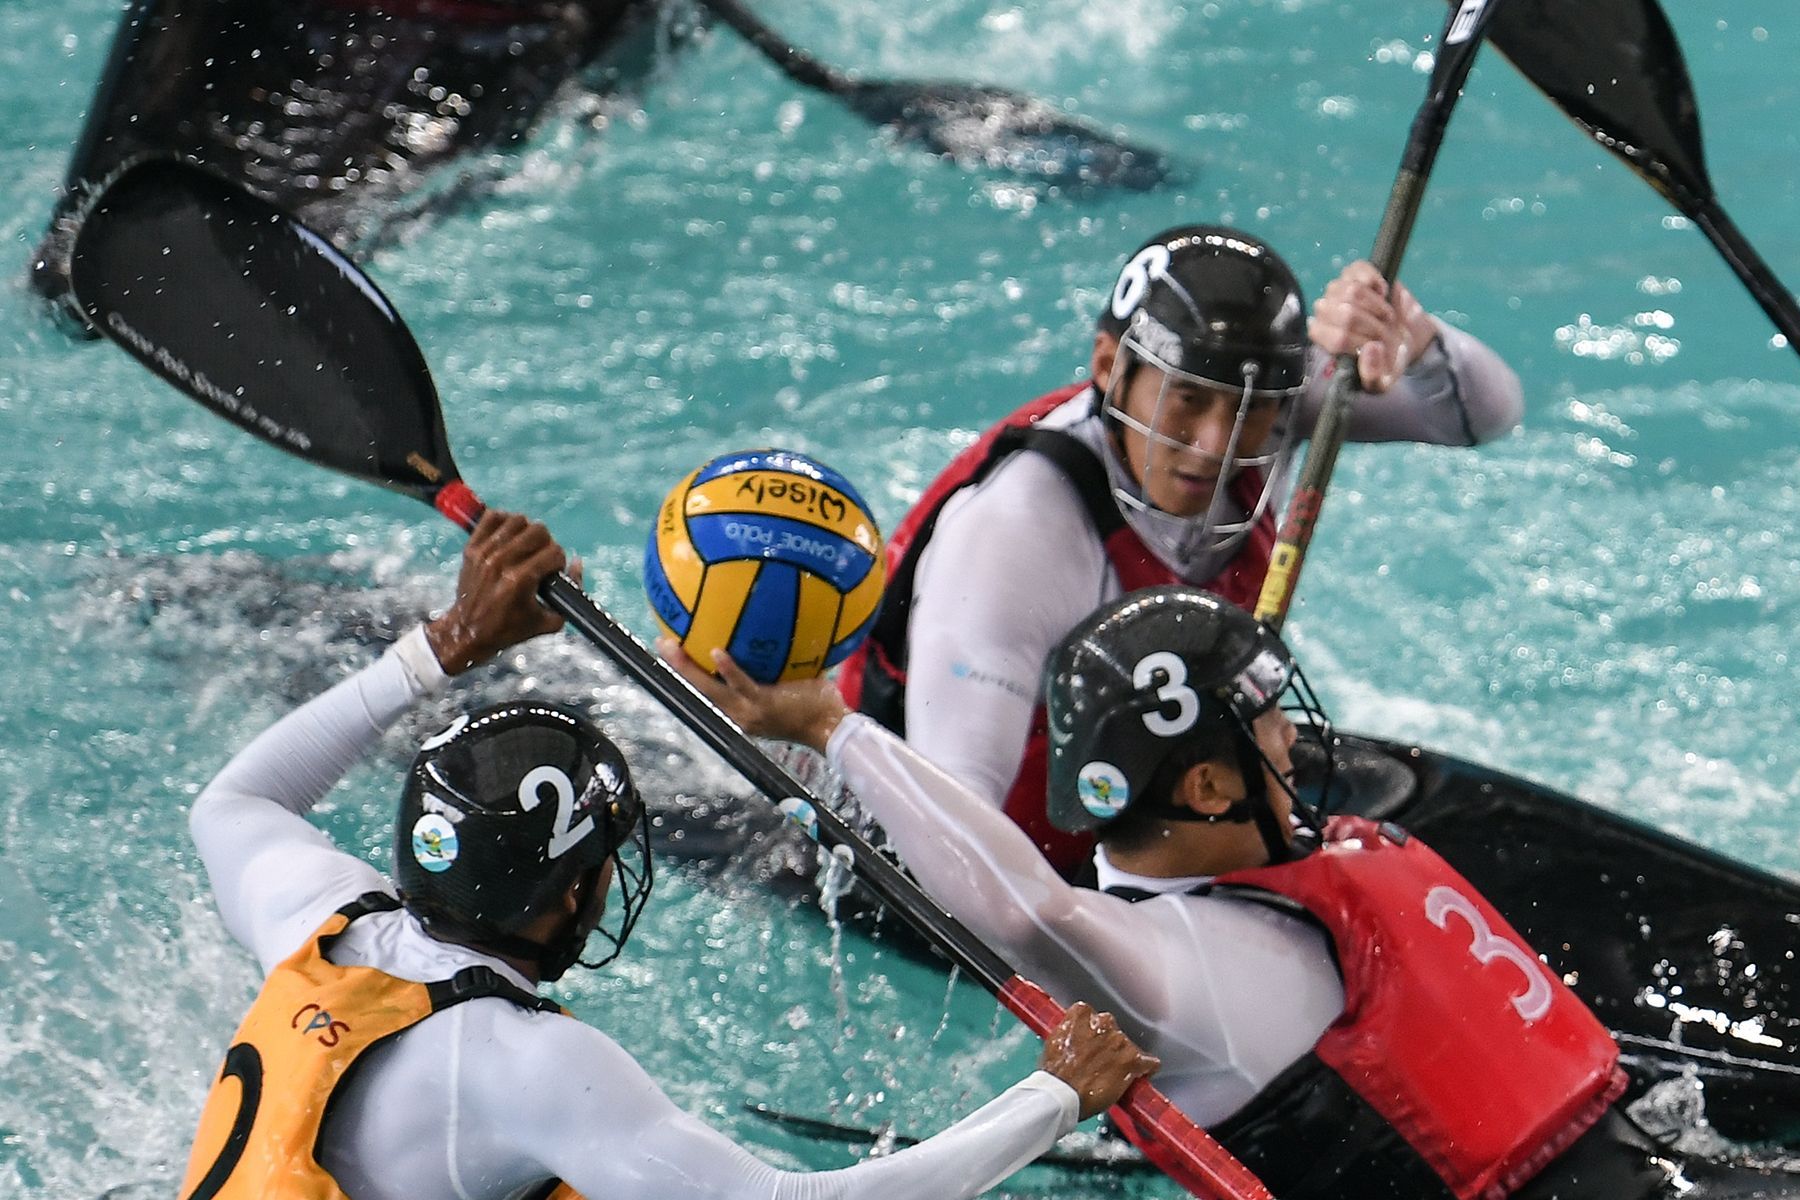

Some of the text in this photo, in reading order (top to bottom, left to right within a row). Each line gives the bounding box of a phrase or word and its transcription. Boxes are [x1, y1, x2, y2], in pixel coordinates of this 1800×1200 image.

[1112, 244, 1170, 320] 6
[736, 474, 846, 522] Wisely
[725, 522, 836, 562] CANOE POLO
[1133, 651, 1199, 737] 3
[518, 765, 596, 860] 2
[1425, 885, 1553, 1021] 3
[292, 1003, 351, 1048] CPS
